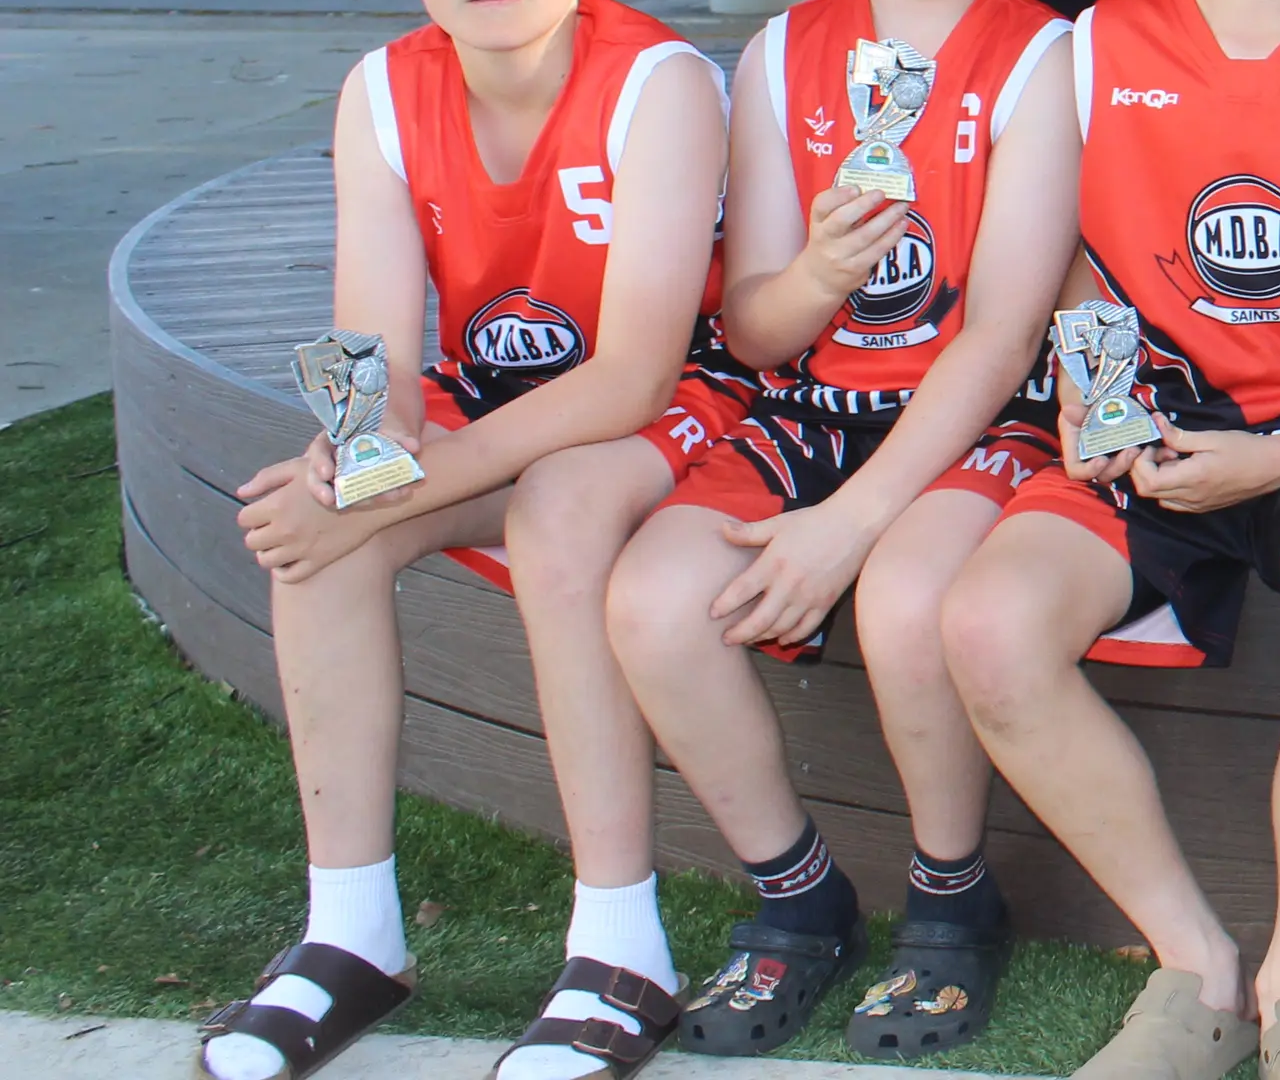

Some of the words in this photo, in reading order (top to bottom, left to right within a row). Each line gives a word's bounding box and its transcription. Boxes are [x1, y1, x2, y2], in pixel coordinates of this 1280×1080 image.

[557, 165, 613, 244] 5
[1230, 308, 1280, 322] SAINTS
[861, 333, 908, 348] SAINTS
